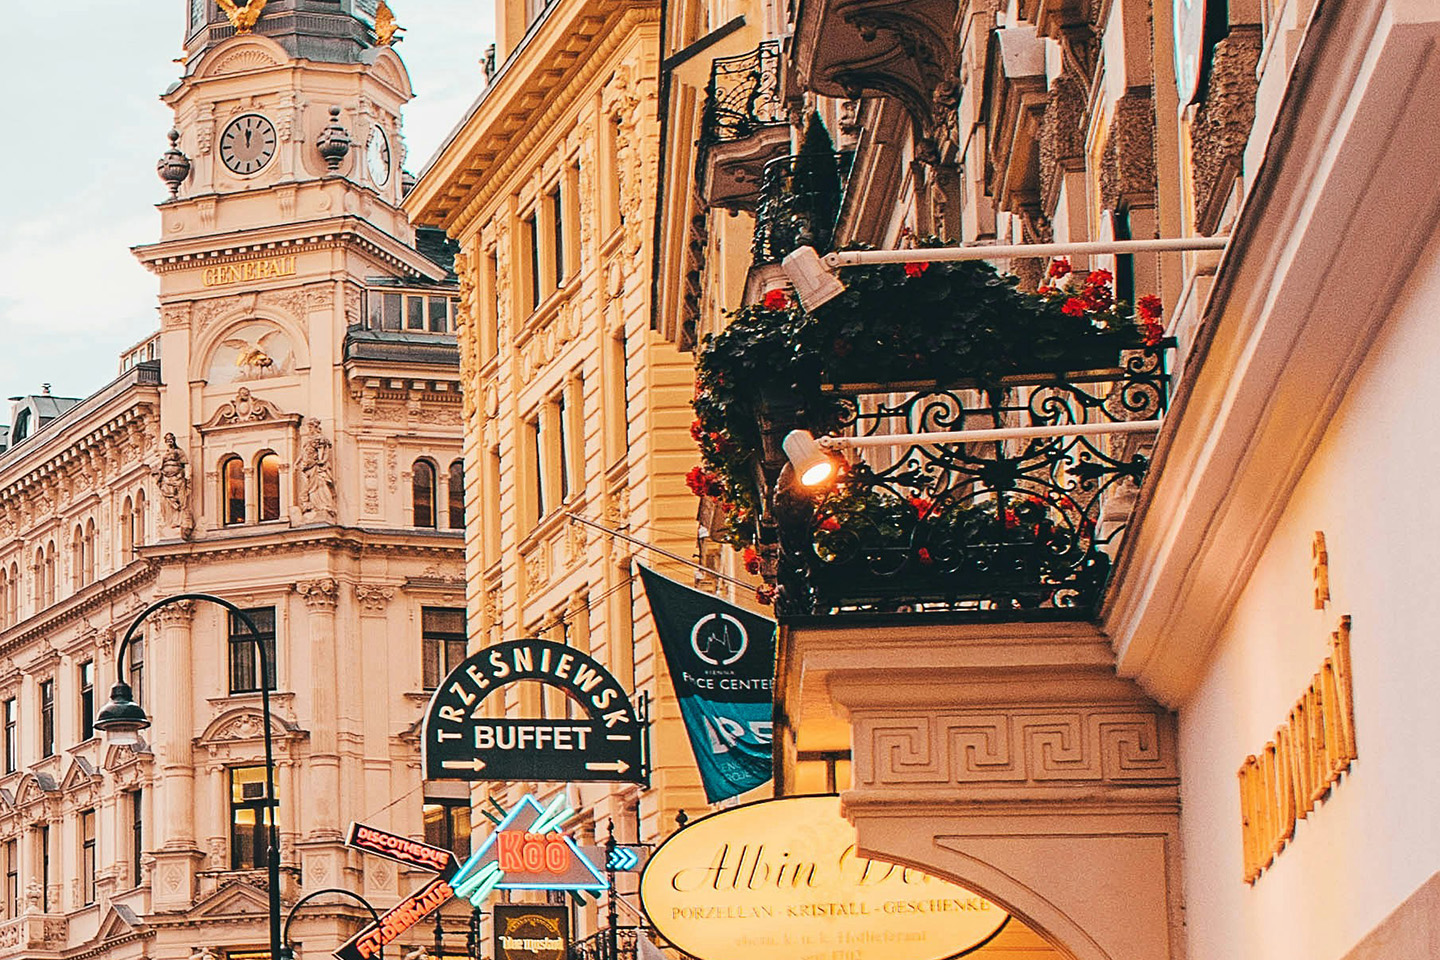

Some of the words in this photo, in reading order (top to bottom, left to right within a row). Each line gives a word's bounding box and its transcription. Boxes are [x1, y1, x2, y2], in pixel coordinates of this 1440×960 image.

[203, 257, 297, 286] GENERALI
[474, 725, 592, 750] BUFFET
[357, 826, 450, 865] DISCOTHEQUE
[671, 843, 819, 892] Albin
[672, 906, 773, 920] PORZELLAN
[786, 902, 869, 917] KRISTALL
[883, 899, 991, 914] GESCHENKE
